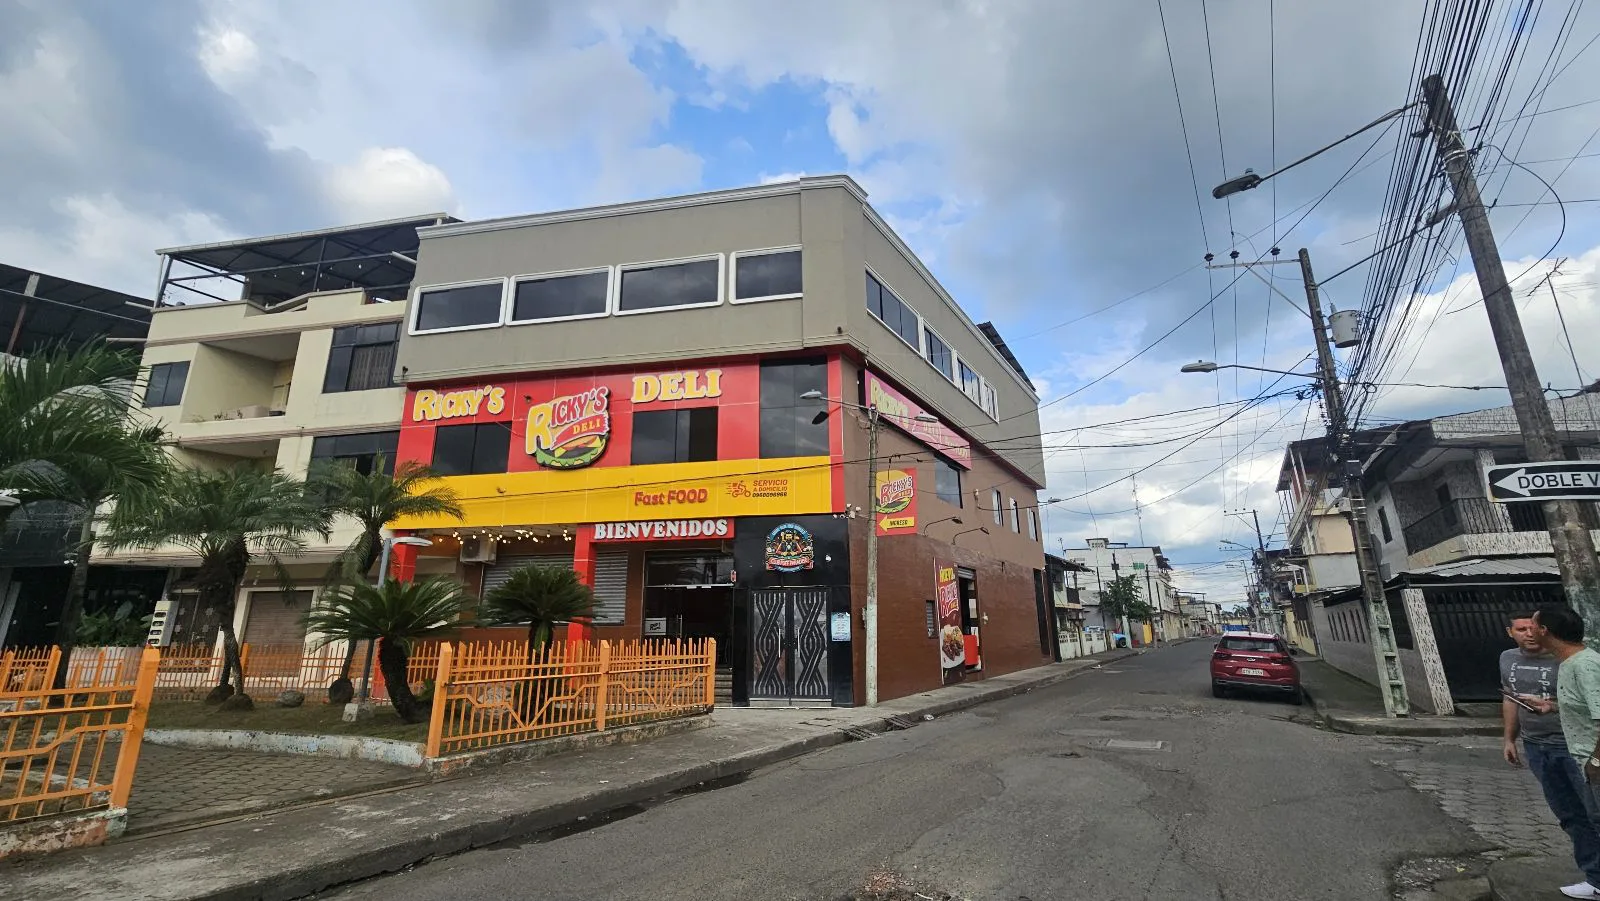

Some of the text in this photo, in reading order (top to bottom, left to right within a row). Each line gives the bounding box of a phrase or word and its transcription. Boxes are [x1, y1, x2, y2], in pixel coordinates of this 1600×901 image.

[632, 369, 722, 404] DELI
[526, 386, 609, 454] RICKY'S
[572, 419, 601, 436] DELI
[753, 479, 788, 487] SERVICIO
[1518, 474, 1584, 489] DOBLE
[634, 487, 708, 506] Fast FOOD
[594, 519, 728, 541] BIENVENIDOS
